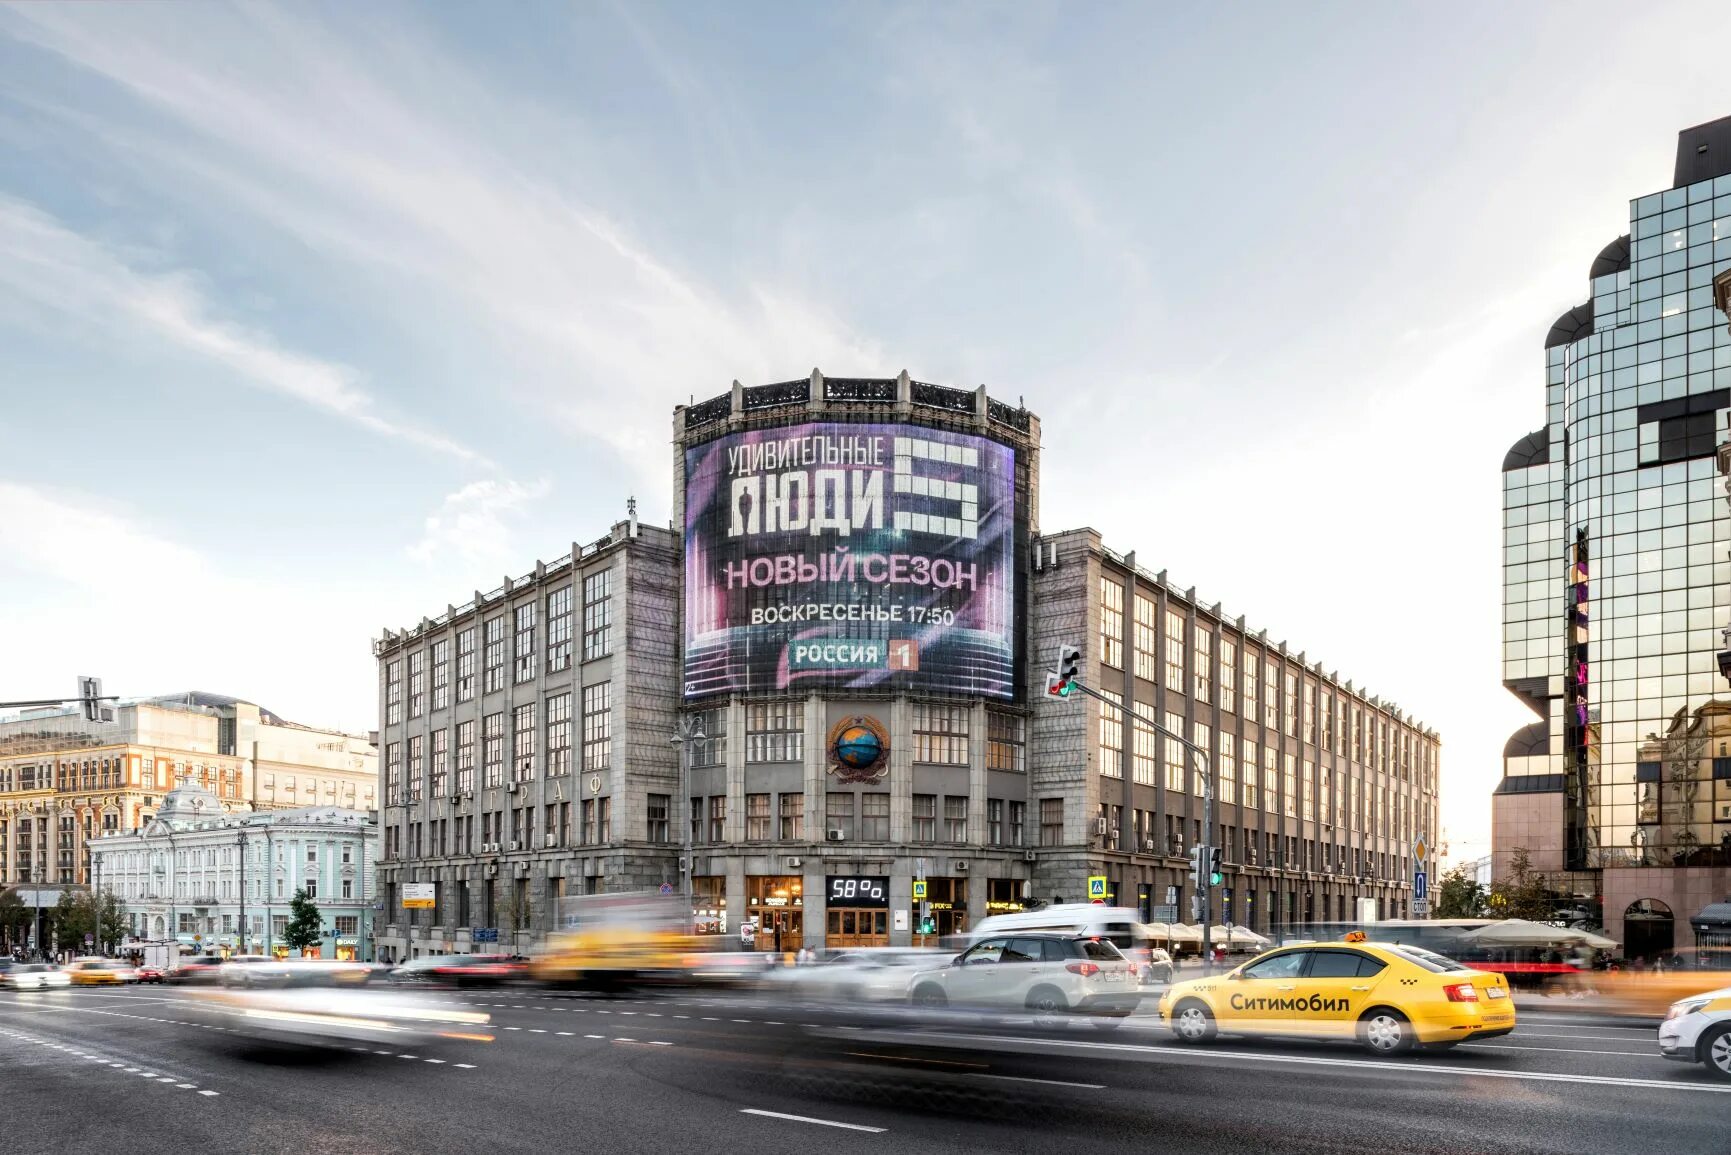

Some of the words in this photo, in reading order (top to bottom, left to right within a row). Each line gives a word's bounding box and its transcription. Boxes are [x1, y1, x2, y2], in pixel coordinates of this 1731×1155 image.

[728, 435, 884, 476] УДИВИТЕЛЬНЫЕ
[728, 469, 884, 538] ЛЮДИ
[728, 546, 853, 591] НОВЫЙ
[863, 554, 977, 591] СЕЗОН
[751, 603, 903, 625] ВОСКРЕСЕНЬЕ
[908, 606, 954, 626] 17:50
[795, 644, 878, 663] РОССИЯ
[898, 644, 911, 667] 1
[1413, 902, 1427, 912] СТОП
[1231, 992, 1350, 1012] Ситимобил
